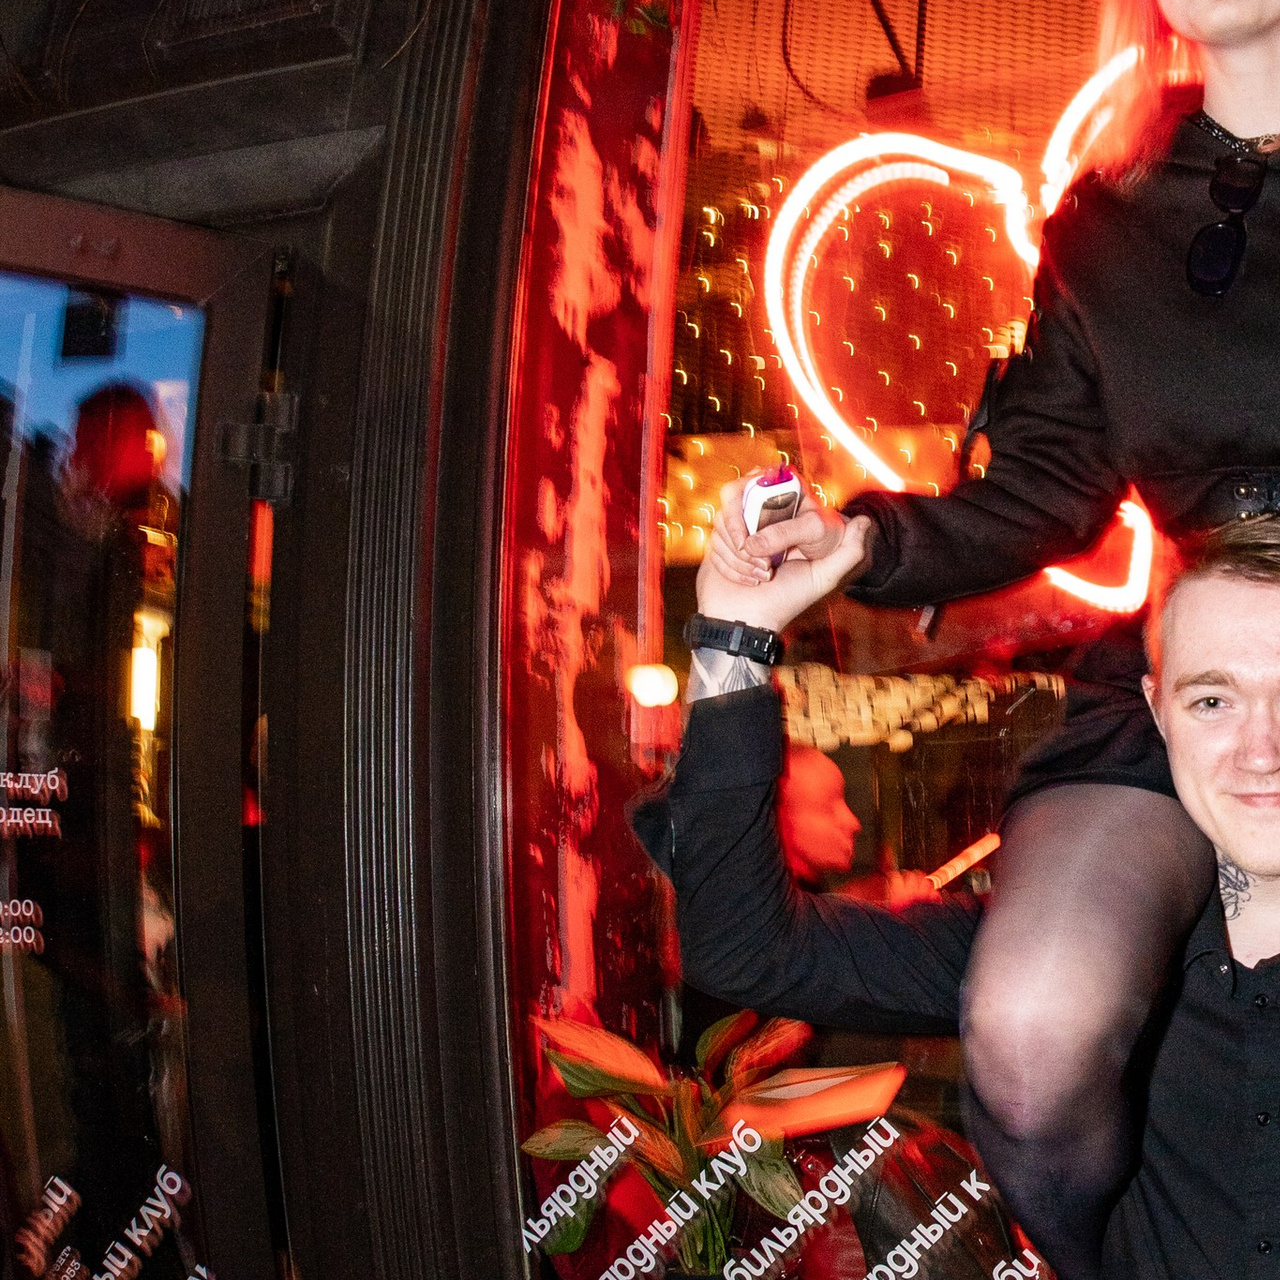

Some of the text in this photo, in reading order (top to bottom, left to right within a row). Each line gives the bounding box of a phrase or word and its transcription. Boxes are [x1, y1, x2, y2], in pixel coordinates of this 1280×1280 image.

[0, 899, 34, 916] :00
[693, 1120, 764, 1201] клуб
[124, 1164, 182, 1247] клуб
